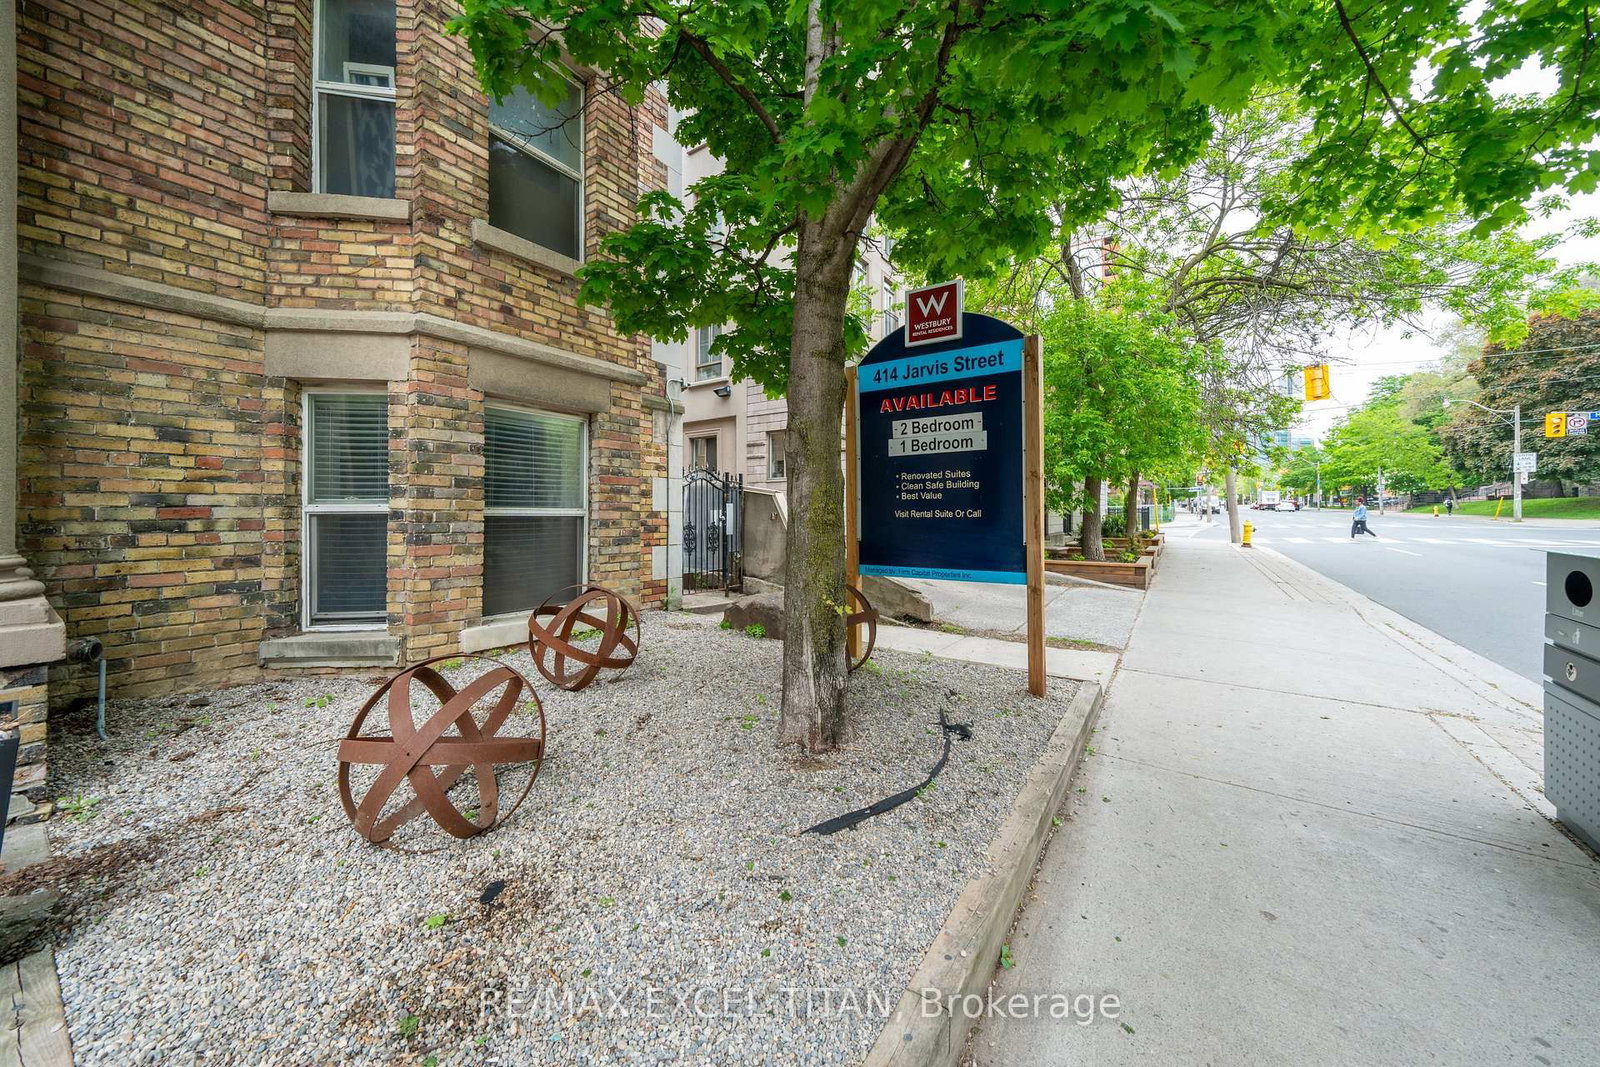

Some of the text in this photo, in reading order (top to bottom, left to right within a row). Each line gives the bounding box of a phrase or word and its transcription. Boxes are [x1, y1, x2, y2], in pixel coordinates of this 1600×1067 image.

[916, 291, 949, 318] W
[914, 317, 952, 330] WESTBURY
[873, 350, 1004, 384] 414 Jarvis Street
[880, 384, 998, 414] AVAILABLE
[900, 418, 974, 435] 2 Bedroom
[900, 437, 973, 453] 1 Bedroom
[901, 470, 971, 480] Renovated Suites
[901, 480, 980, 490] Clean Safe Building
[901, 492, 943, 500] Best Value
[894, 509, 982, 518] Visit Rental Suite Or Call
